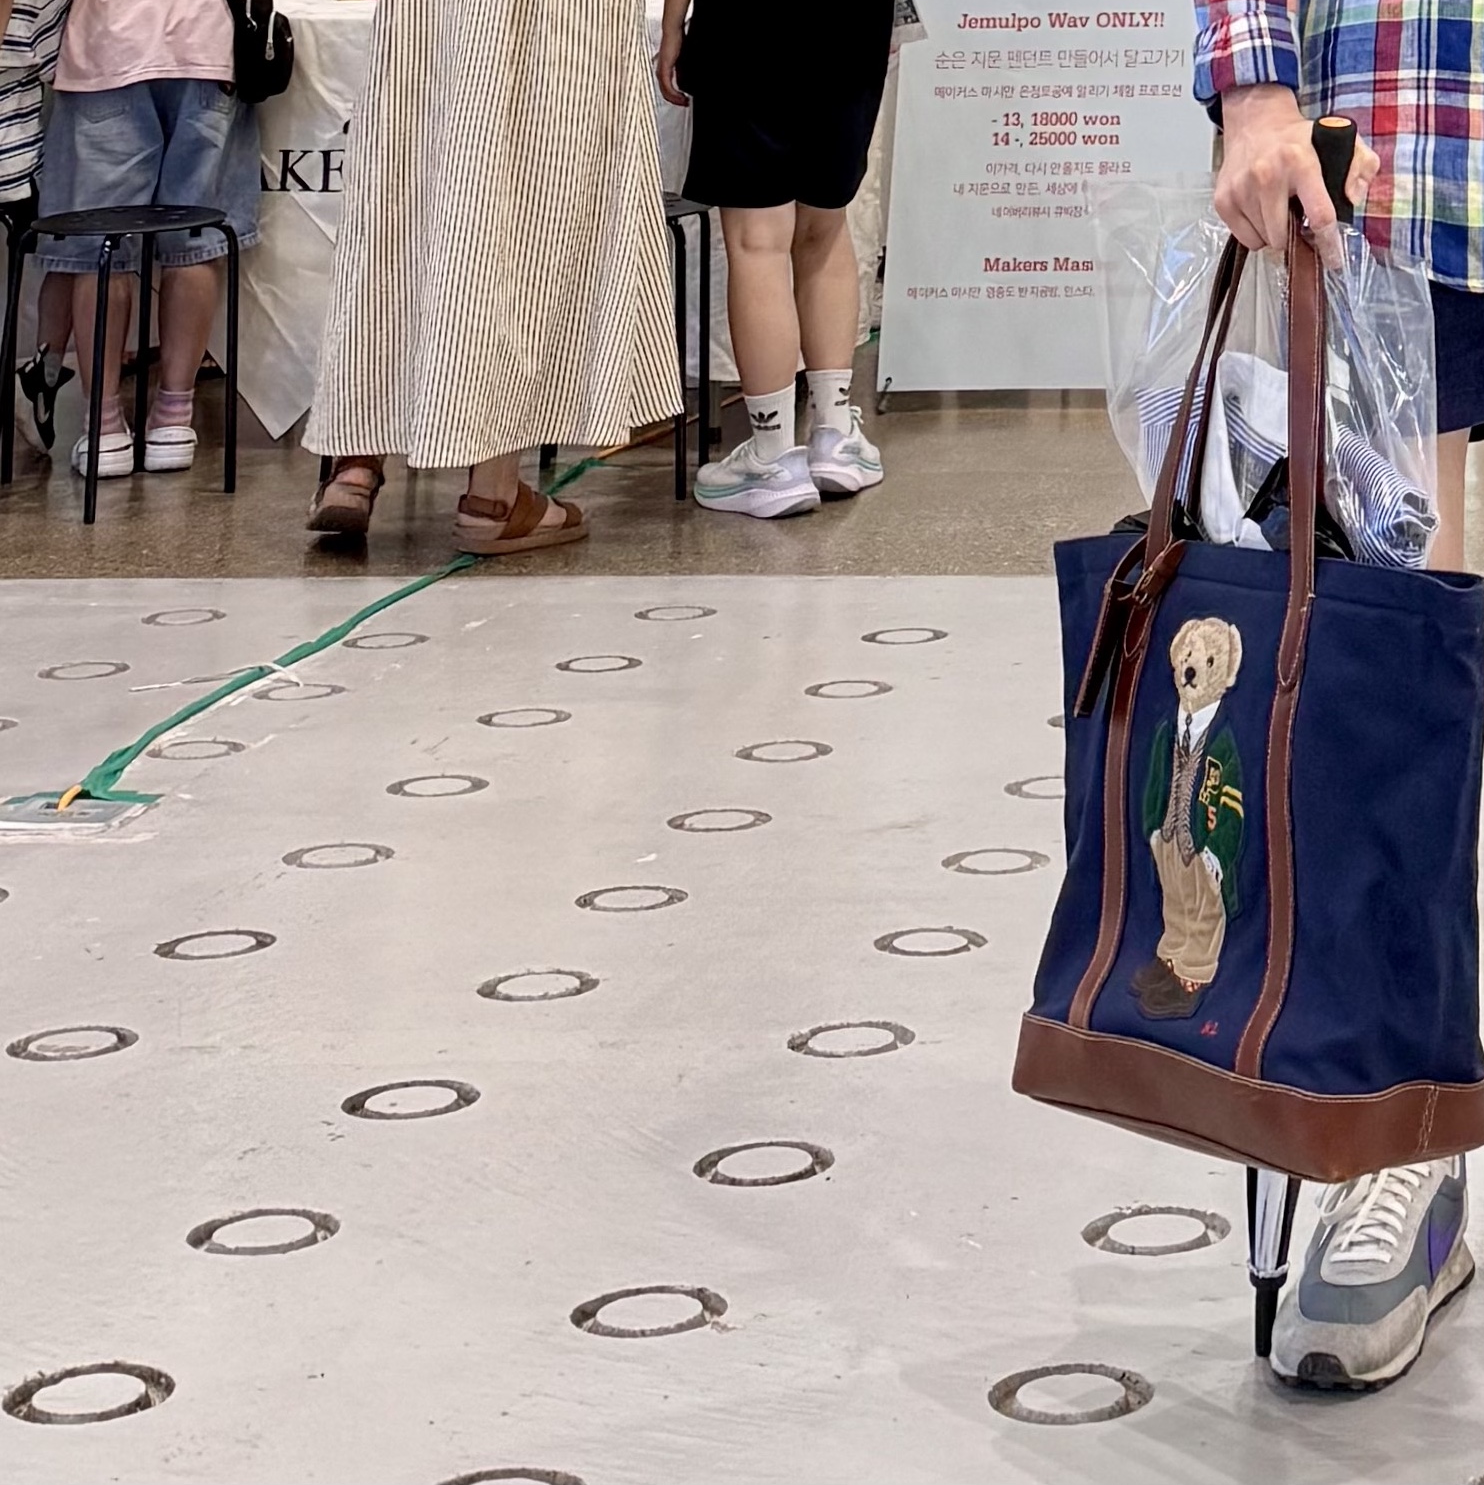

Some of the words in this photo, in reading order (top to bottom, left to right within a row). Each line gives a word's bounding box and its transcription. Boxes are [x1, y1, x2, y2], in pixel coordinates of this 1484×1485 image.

[957, 13, 1041, 32] Jemulpo
[1047, 12, 1090, 29] Wav
[1096, 12, 1165, 28] ONLY!!
[934, 51, 967, 69] 순은
[970, 50, 1003, 69] 지문
[1057, 49, 1119, 69] 만들어서
[1123, 48, 1185, 67] 달고가기
[934, 85, 978, 99] 메이커스
[981, 85, 1015, 98] 마시안
[1076, 84, 1110, 98] 알리기
[1138, 84, 1182, 97] 프로모션
[1002, 113, 1025, 128] 13,
[1031, 112, 1078, 127] 18000
[1083, 115, 1121, 126] won
[992, 132, 1010, 146] 14
[1029, 131, 1077, 146] 25000
[1082, 134, 1120, 146] won
[1024, 162, 1048, 175] 다시
[1098, 161, 1132, 175] 몰라요
[983, 258, 1048, 272] Makers
[907, 287, 948, 299] 메이커스
